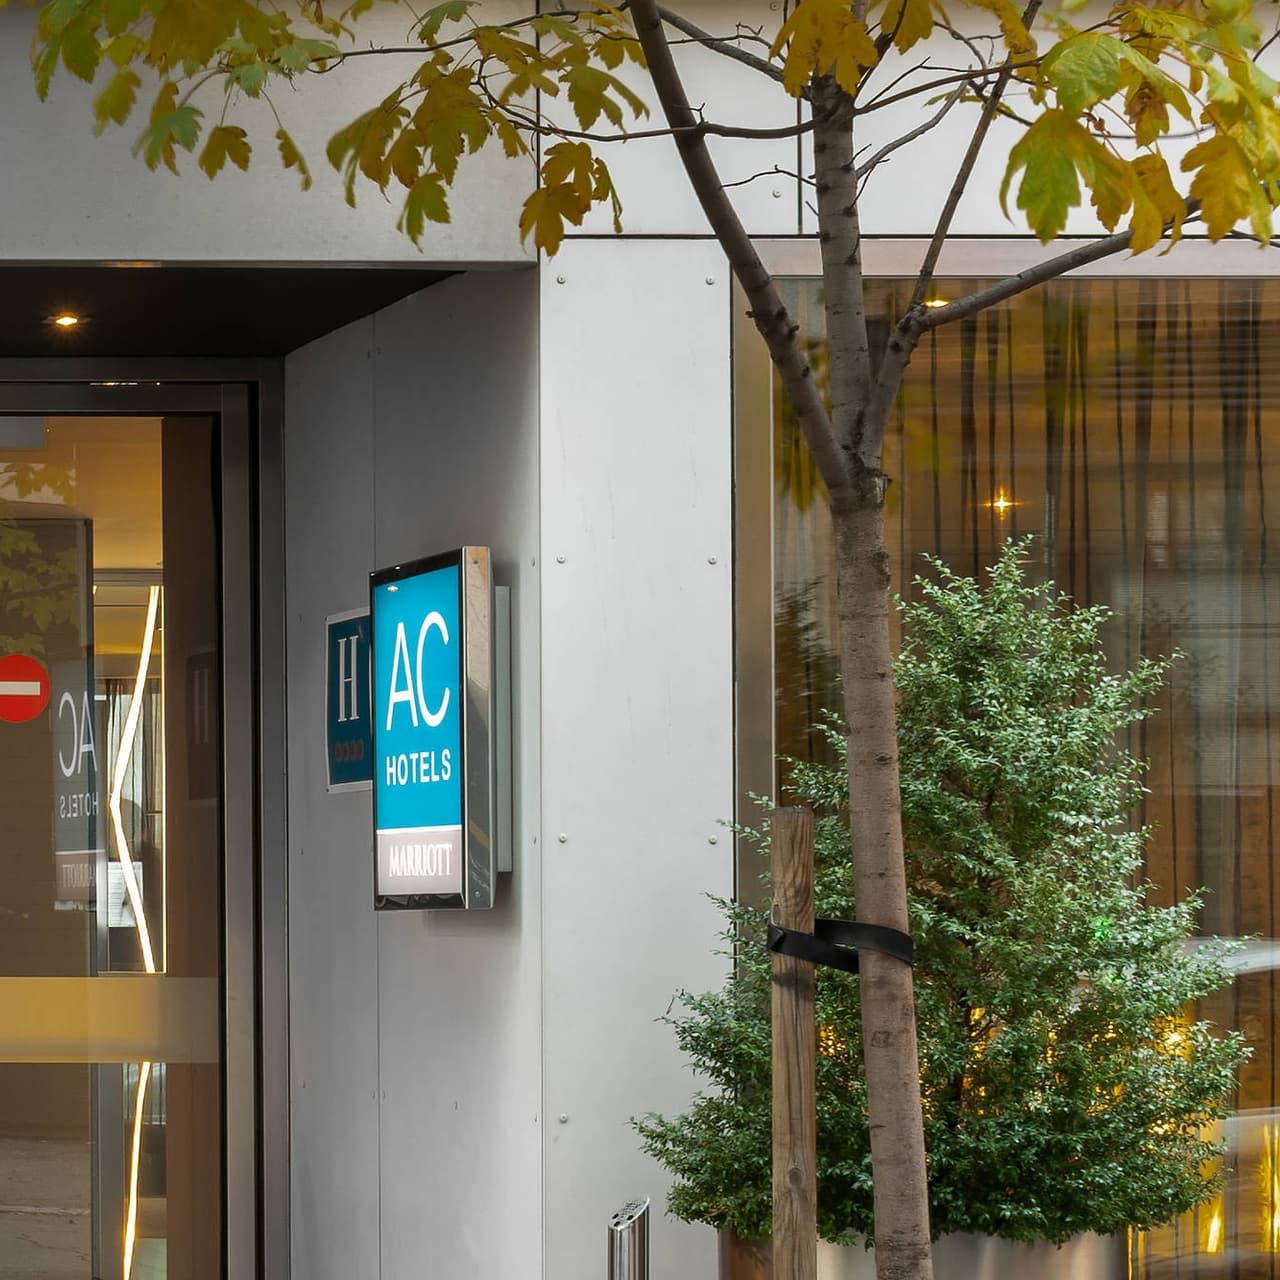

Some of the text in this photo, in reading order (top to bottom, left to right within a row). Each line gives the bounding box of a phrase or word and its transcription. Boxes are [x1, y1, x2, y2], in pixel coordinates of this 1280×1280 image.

[386, 611, 451, 732] AC
[386, 748, 452, 787] HOTELS
[388, 843, 453, 878] MARRIOTT
